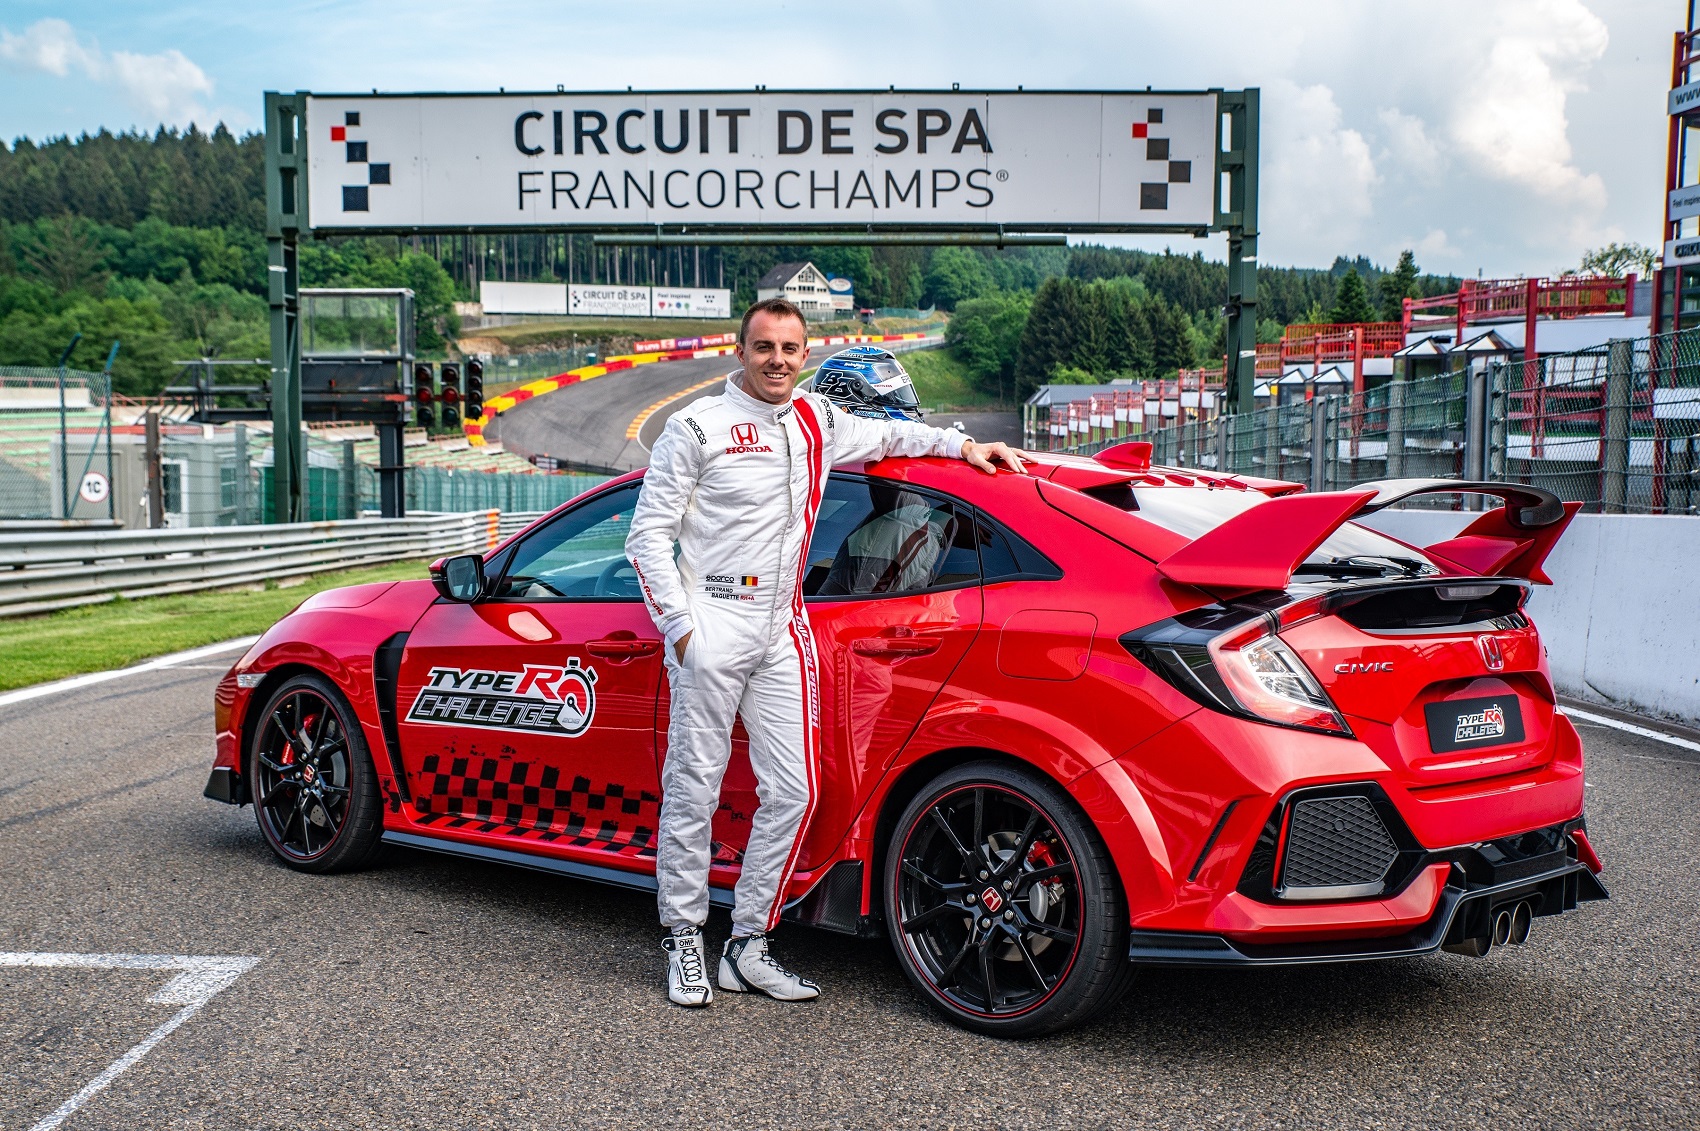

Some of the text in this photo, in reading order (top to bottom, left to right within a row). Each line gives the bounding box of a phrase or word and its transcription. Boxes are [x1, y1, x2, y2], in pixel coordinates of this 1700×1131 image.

[514, 108, 993, 155] CIRCUIT DE SPA
[583, 290, 646, 300] CIRCUIT DE SPA
[583, 301, 647, 310] FRANCORCHAMPS
[684, 417, 707, 446] sparco
[725, 445, 773, 454] HONDA
[86, 481, 101, 493] 1C
[705, 575, 735, 584] sparco
[711, 592, 740, 600] BAGUETTE
[1334, 661, 1394, 674] CIVIC
[430, 667, 563, 700] TYPE R
[810, 670, 819, 728] Honda
[414, 694, 561, 727] CHALLENGE
[1459, 710, 1495, 725] TYPE R
[1457, 724, 1497, 738] CHALLENGE
[678, 939, 695, 948] OMP
